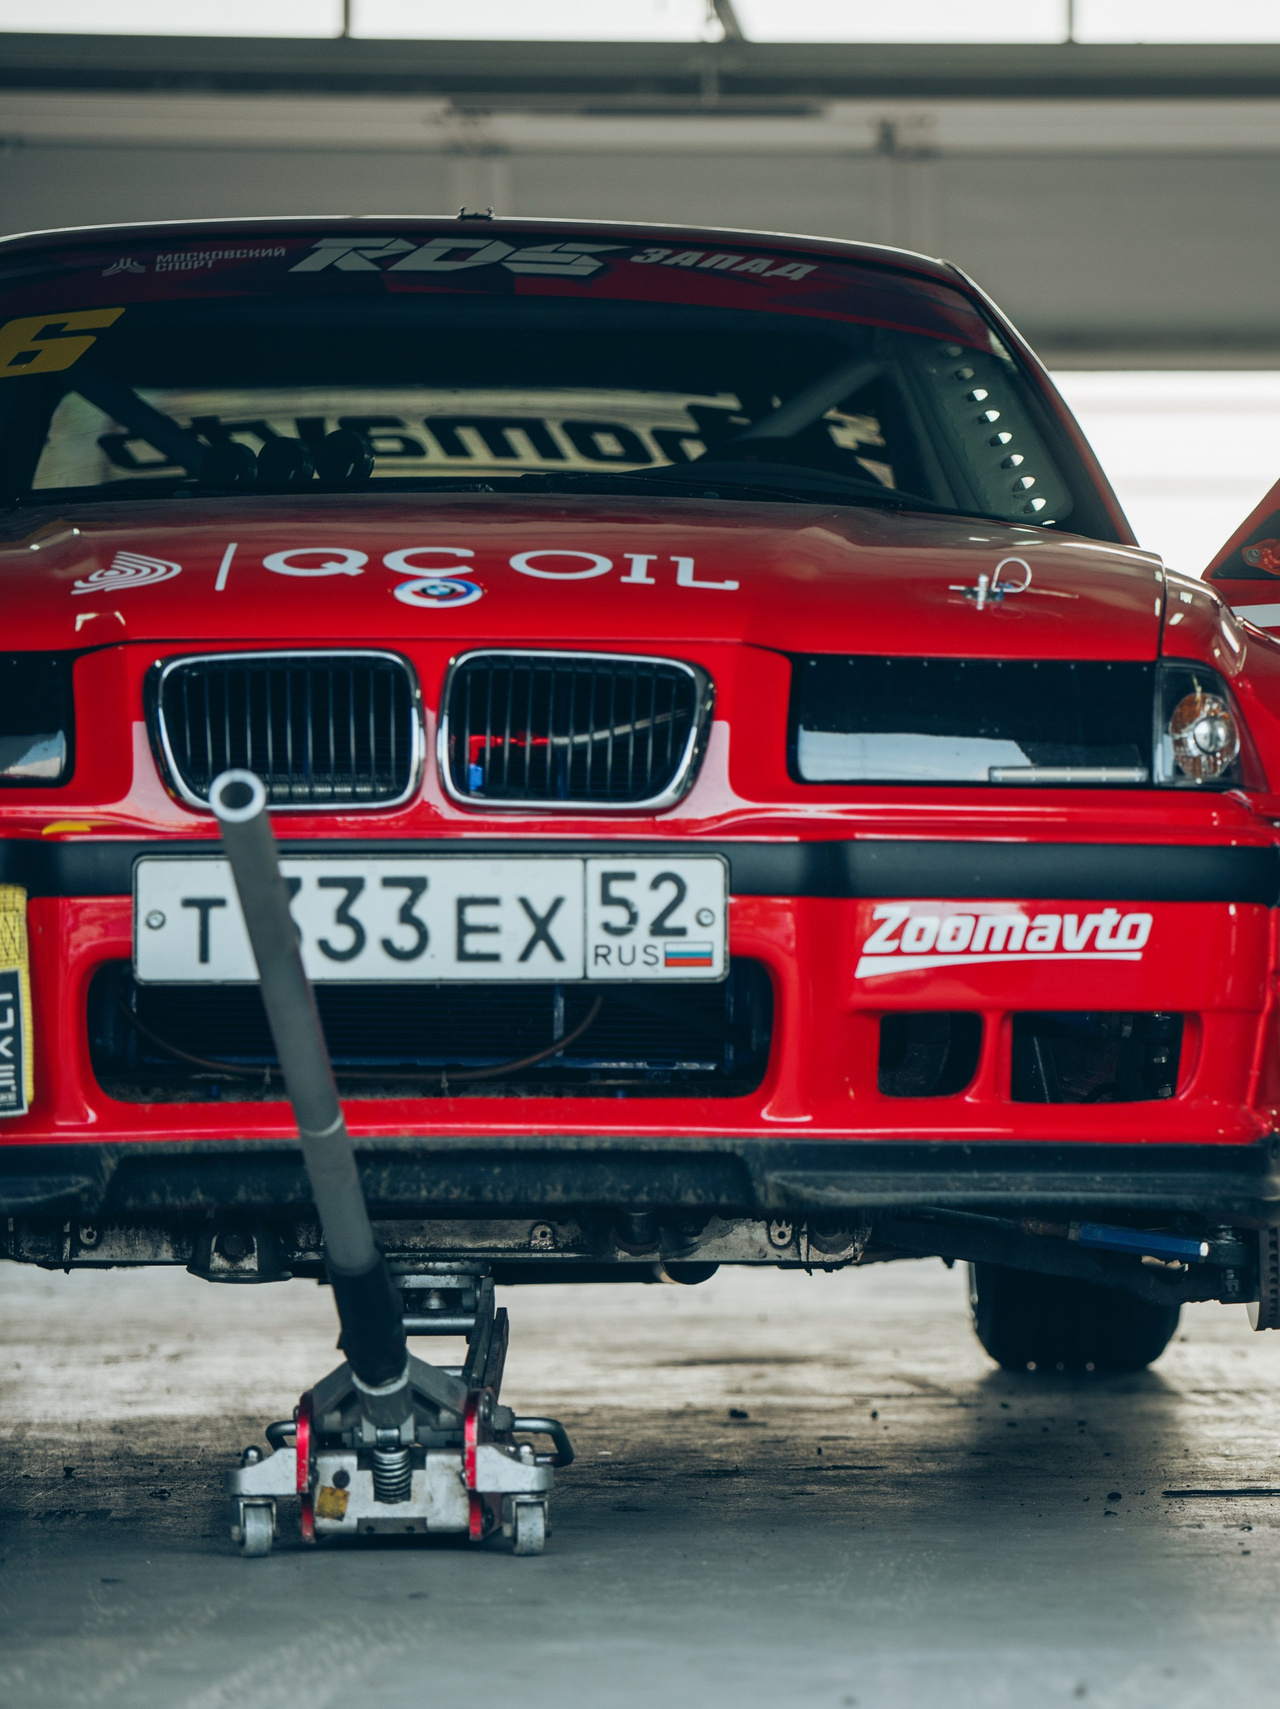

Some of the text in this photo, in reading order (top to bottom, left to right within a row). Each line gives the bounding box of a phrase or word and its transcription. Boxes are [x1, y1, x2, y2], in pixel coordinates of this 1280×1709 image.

[155, 247, 287, 263] МОСКОВСКИЙ
[155, 259, 214, 273] СПОРТ
[288, 238, 819, 281] RDS ЗАПАД
[509, 549, 739, 590] OIL
[600, 871, 688, 937] 52
[861, 904, 1153, 954] Zoomavto
[594, 943, 660, 967] RUS
